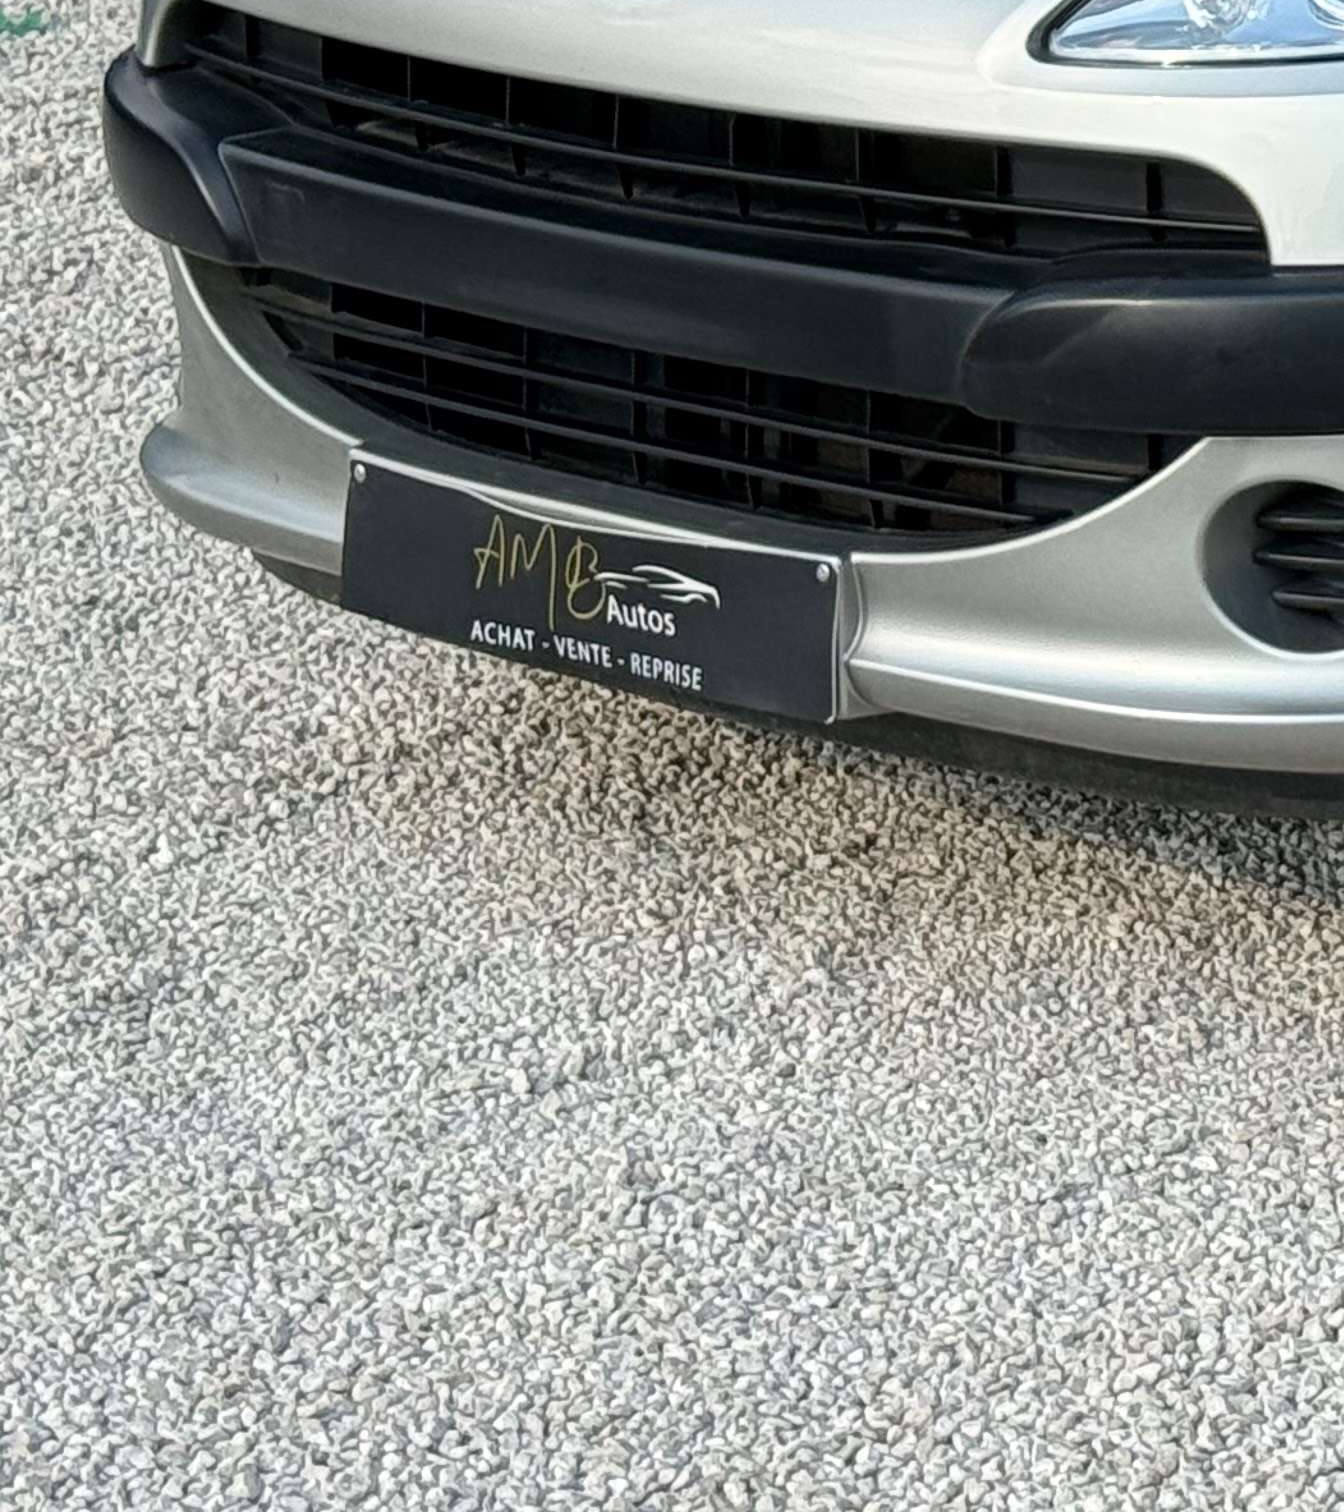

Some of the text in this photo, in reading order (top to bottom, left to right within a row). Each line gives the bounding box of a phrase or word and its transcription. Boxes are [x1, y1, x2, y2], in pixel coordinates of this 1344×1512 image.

[606, 594, 676, 637] Autos
[470, 619, 536, 651] ACHAT
[553, 634, 613, 669] VENTE
[629, 651, 703, 692] REPRISE
